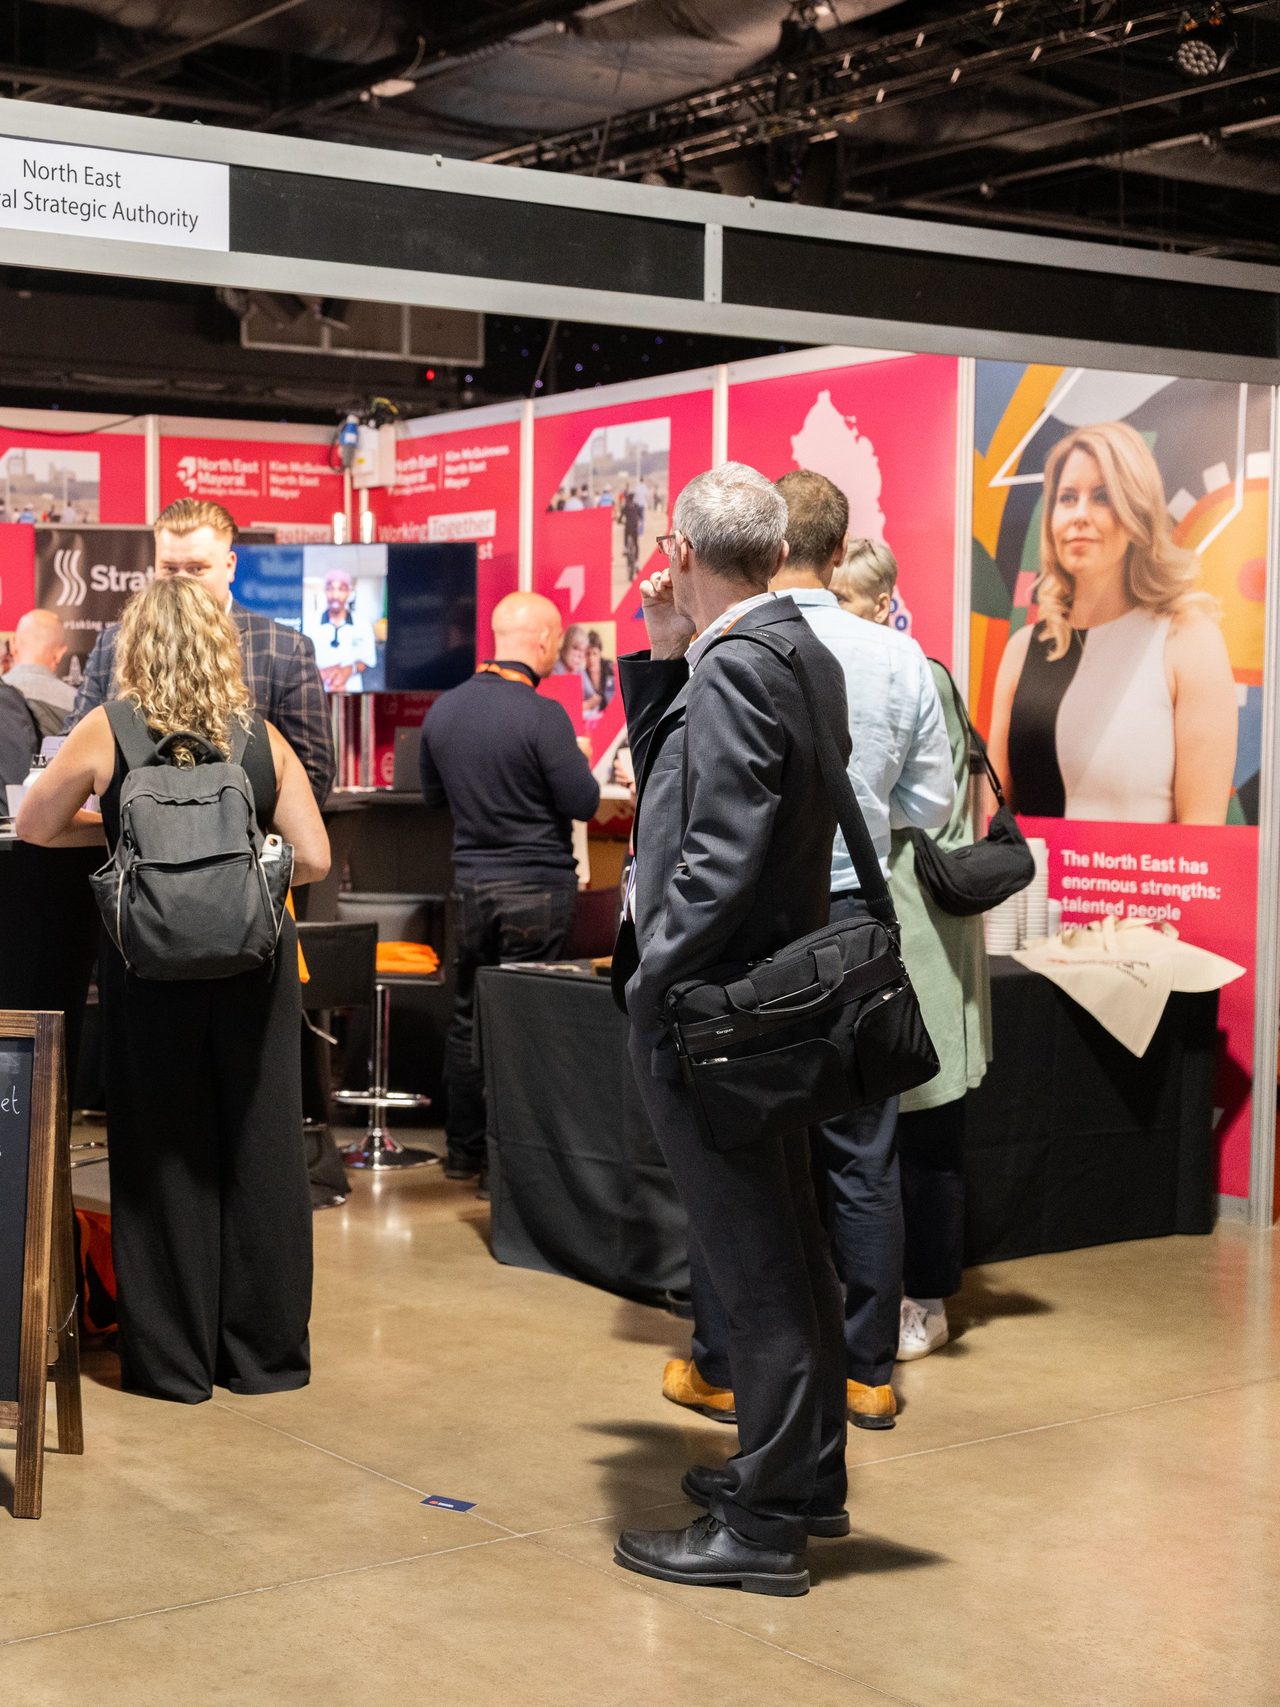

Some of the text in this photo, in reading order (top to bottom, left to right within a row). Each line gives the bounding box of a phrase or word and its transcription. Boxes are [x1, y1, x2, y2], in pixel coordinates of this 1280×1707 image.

[23, 159, 122, 189] North East
[23, 191, 108, 222] Strategic
[112, 201, 200, 234] Authority
[197, 457, 260, 474] North East
[197, 472, 247, 489] Mayoral
[270, 474, 320, 487] North East
[270, 487, 301, 500] Mayor
[377, 515, 491, 542] Working Together
[1061, 849, 1209, 876] The North East has
[1061, 874, 1222, 902] enormous strengths:
[1061, 895, 1182, 922] talented people
